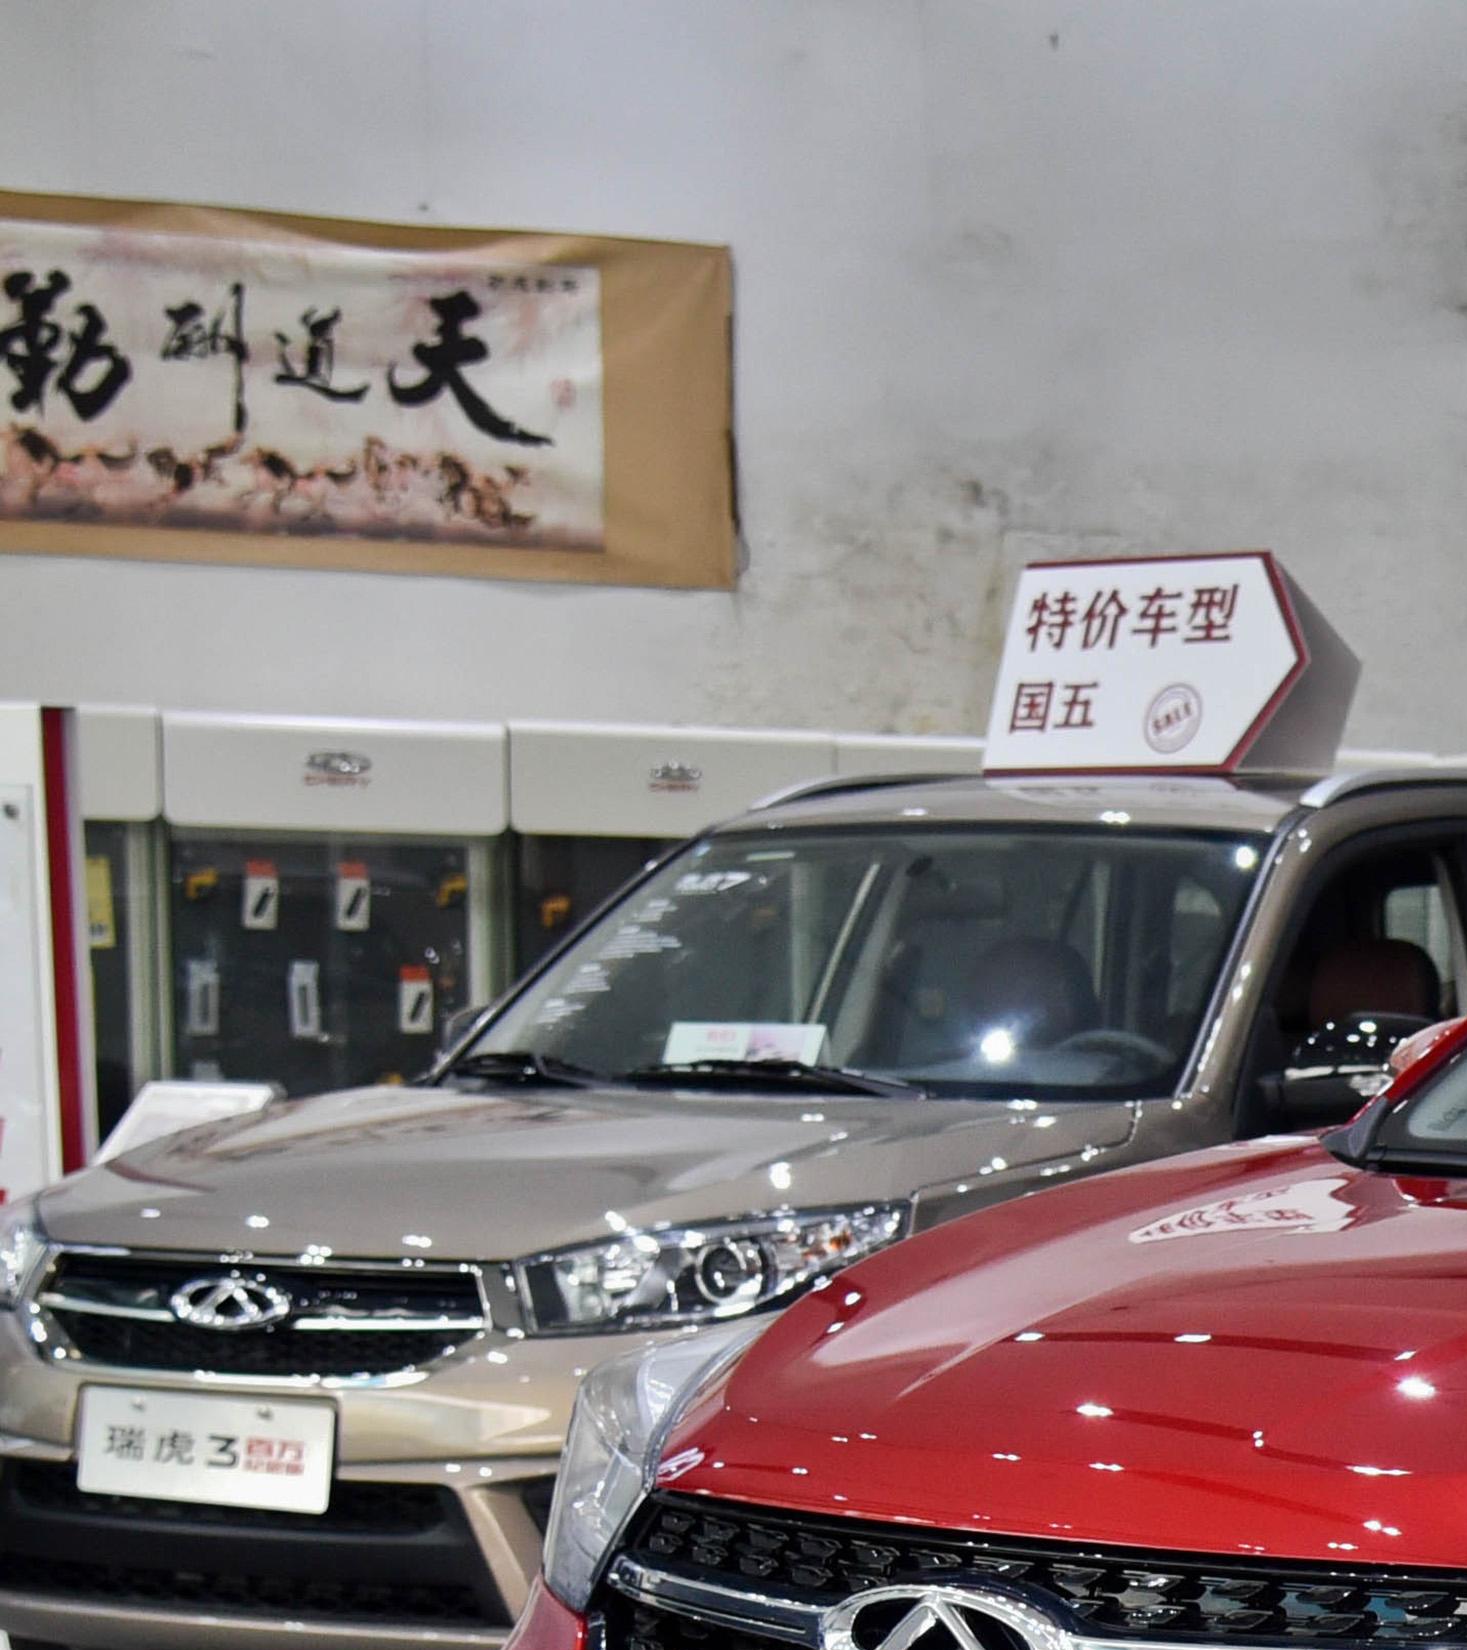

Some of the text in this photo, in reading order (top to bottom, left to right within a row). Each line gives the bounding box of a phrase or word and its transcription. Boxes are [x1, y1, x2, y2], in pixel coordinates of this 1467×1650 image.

[1026, 584, 1239, 651] 特价车型
[1009, 681, 1099, 734] 国五
